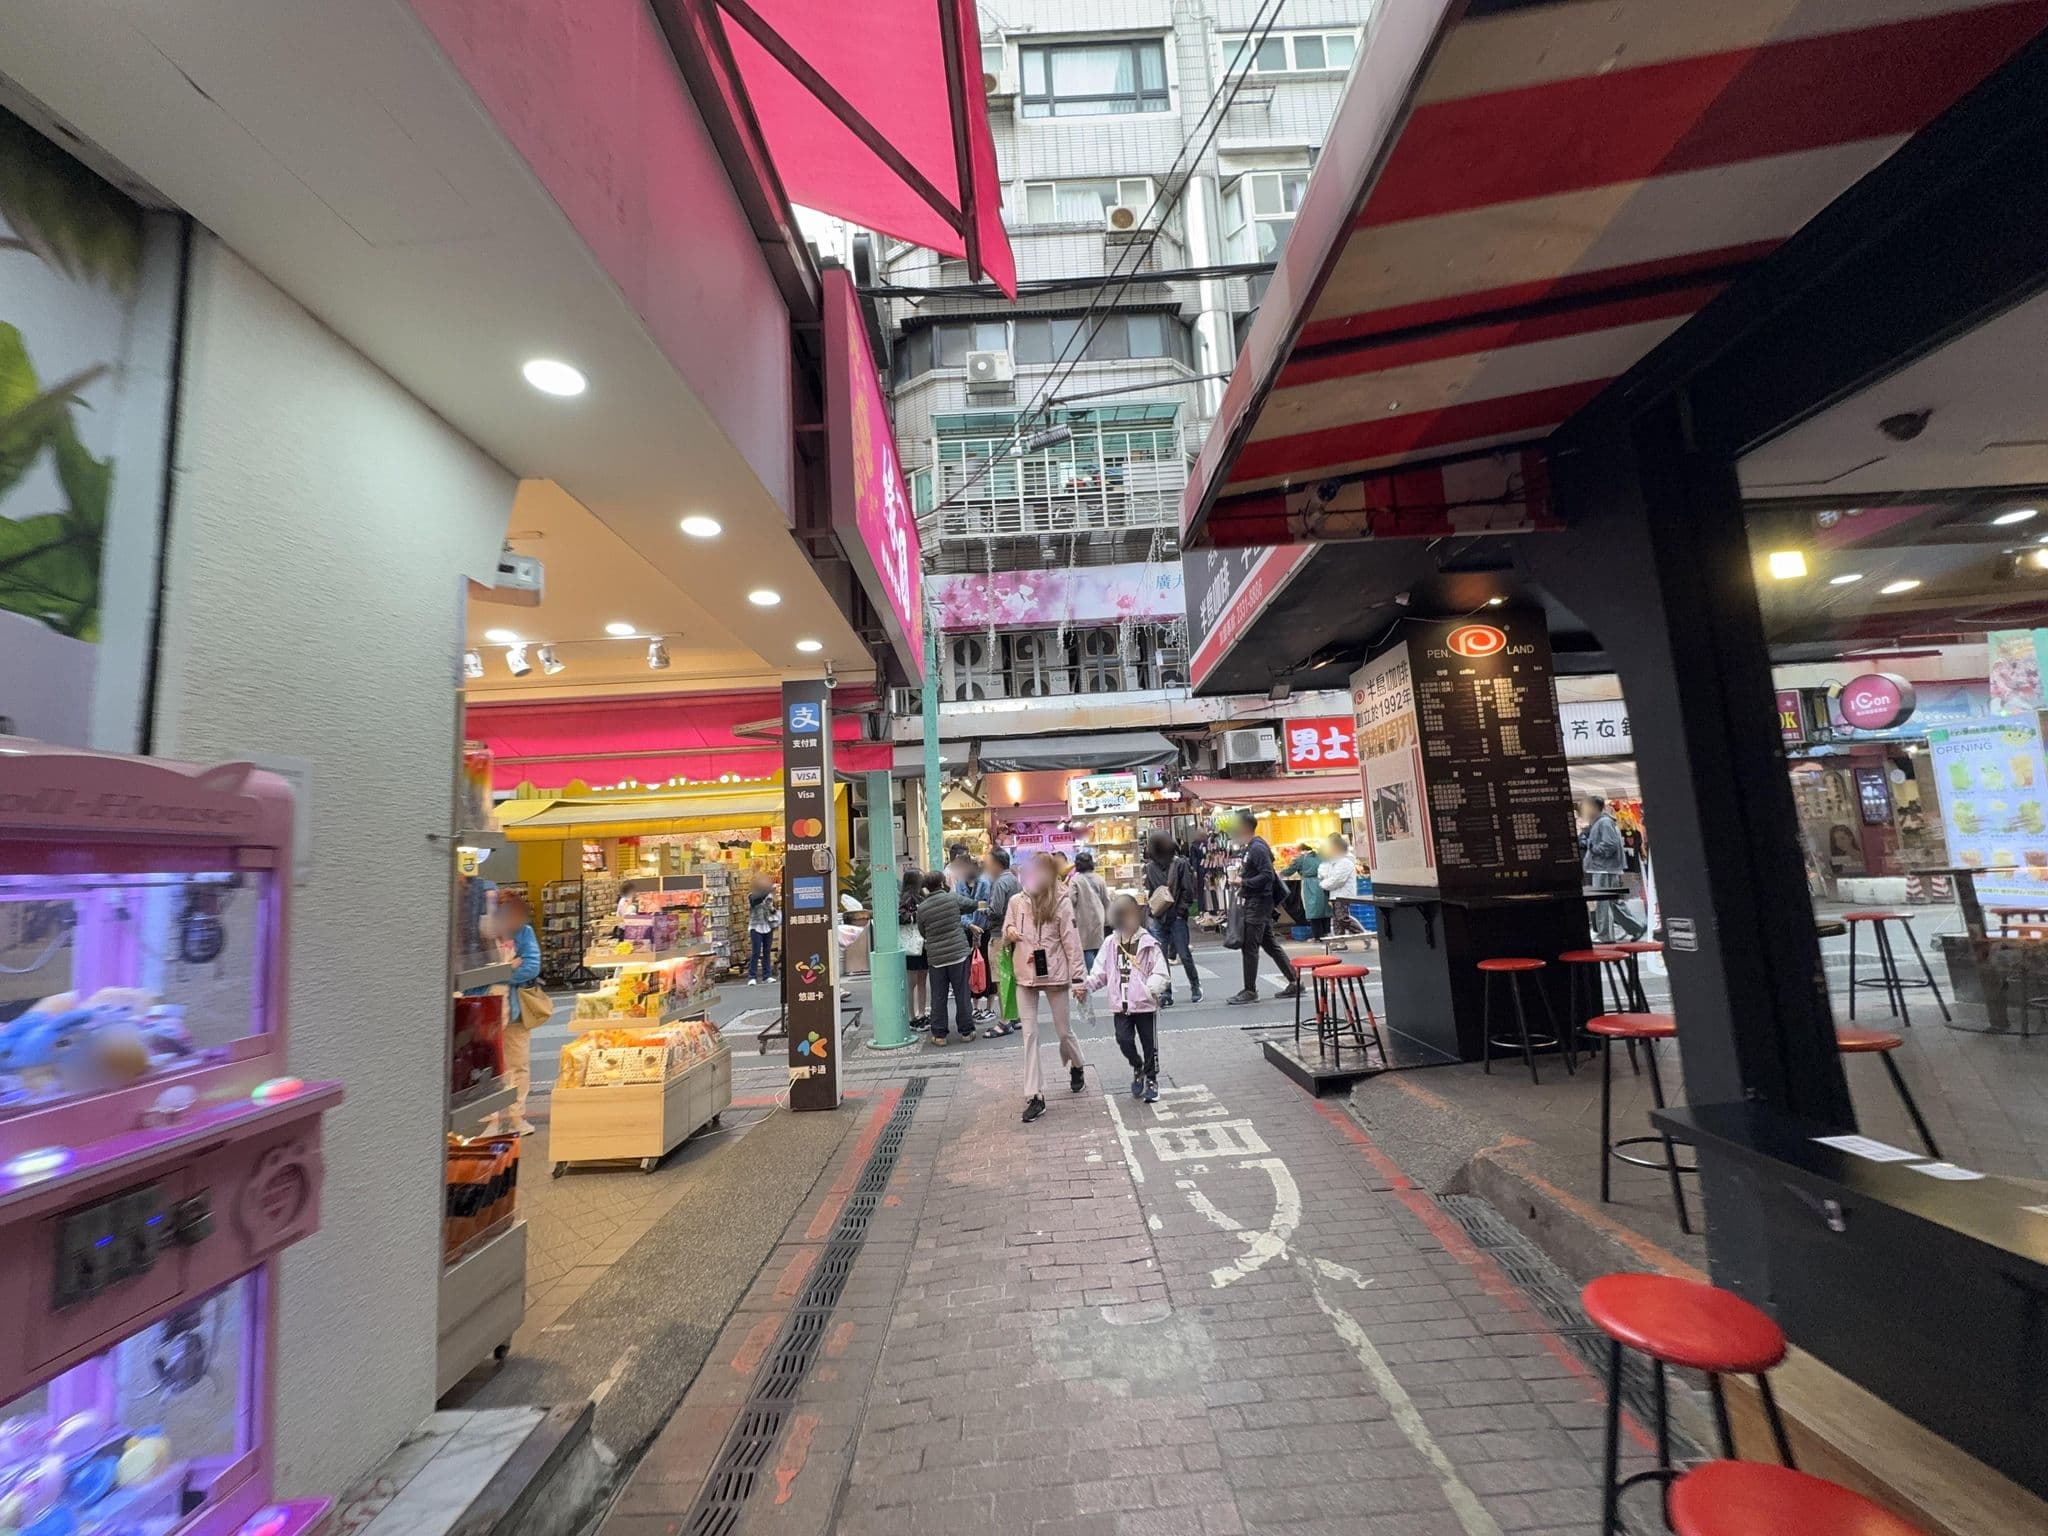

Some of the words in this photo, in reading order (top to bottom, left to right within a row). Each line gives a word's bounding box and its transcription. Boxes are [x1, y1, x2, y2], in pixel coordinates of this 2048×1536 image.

[1507, 645, 1534, 655] LAND
[1366, 660, 1408, 700] 半島咖啡
[1291, 727, 1359, 762] 男士
[1936, 742, 1993, 755] OPENING
[796, 772, 817, 781] VISA
[797, 790, 815, 799] Visa
[808, 1065, 827, 1075] 卡通
